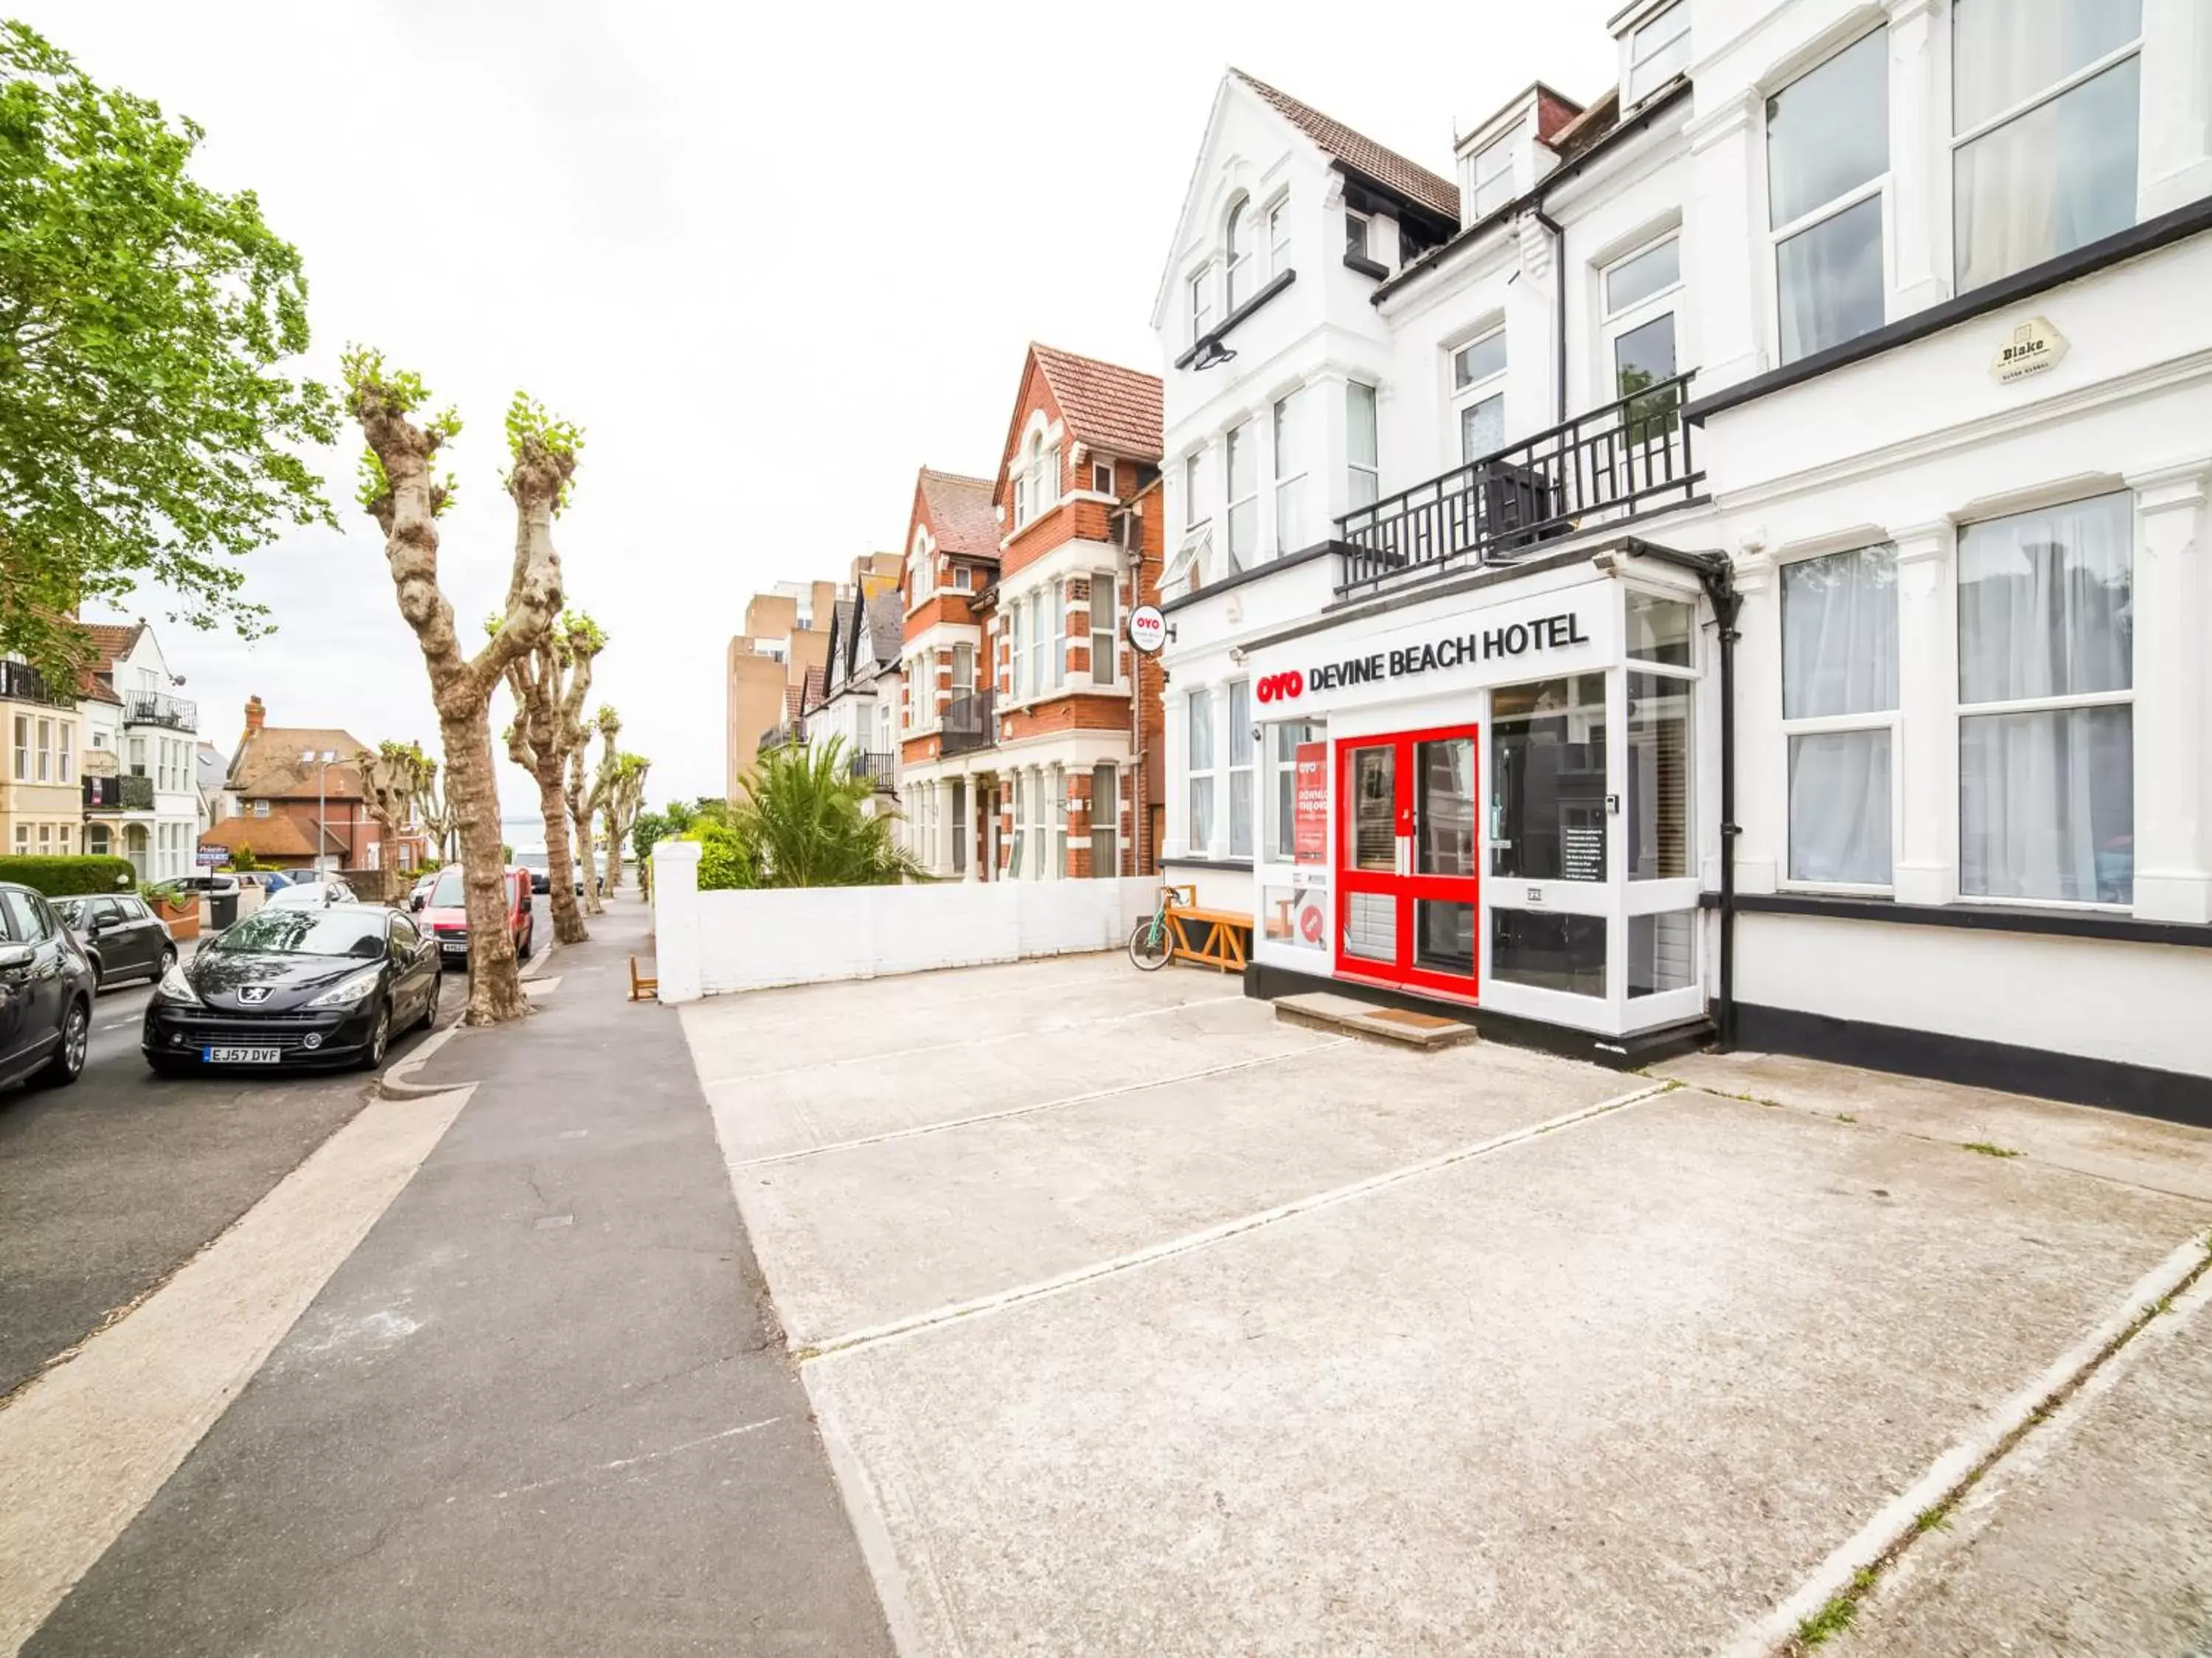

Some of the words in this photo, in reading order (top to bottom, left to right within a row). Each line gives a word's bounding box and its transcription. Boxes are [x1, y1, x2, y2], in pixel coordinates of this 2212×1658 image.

[2003, 340, 2043, 361] Blake
[1137, 617, 1159, 629] OYO
[1256, 670, 1304, 703] OYO
[1310, 653, 1385, 692] DEVINE
[1390, 634, 1475, 676] BEACH
[1483, 612, 1590, 659] HOTEL
[213, 1050, 248, 1061] EJ57
[251, 1050, 278, 1061] DVF
